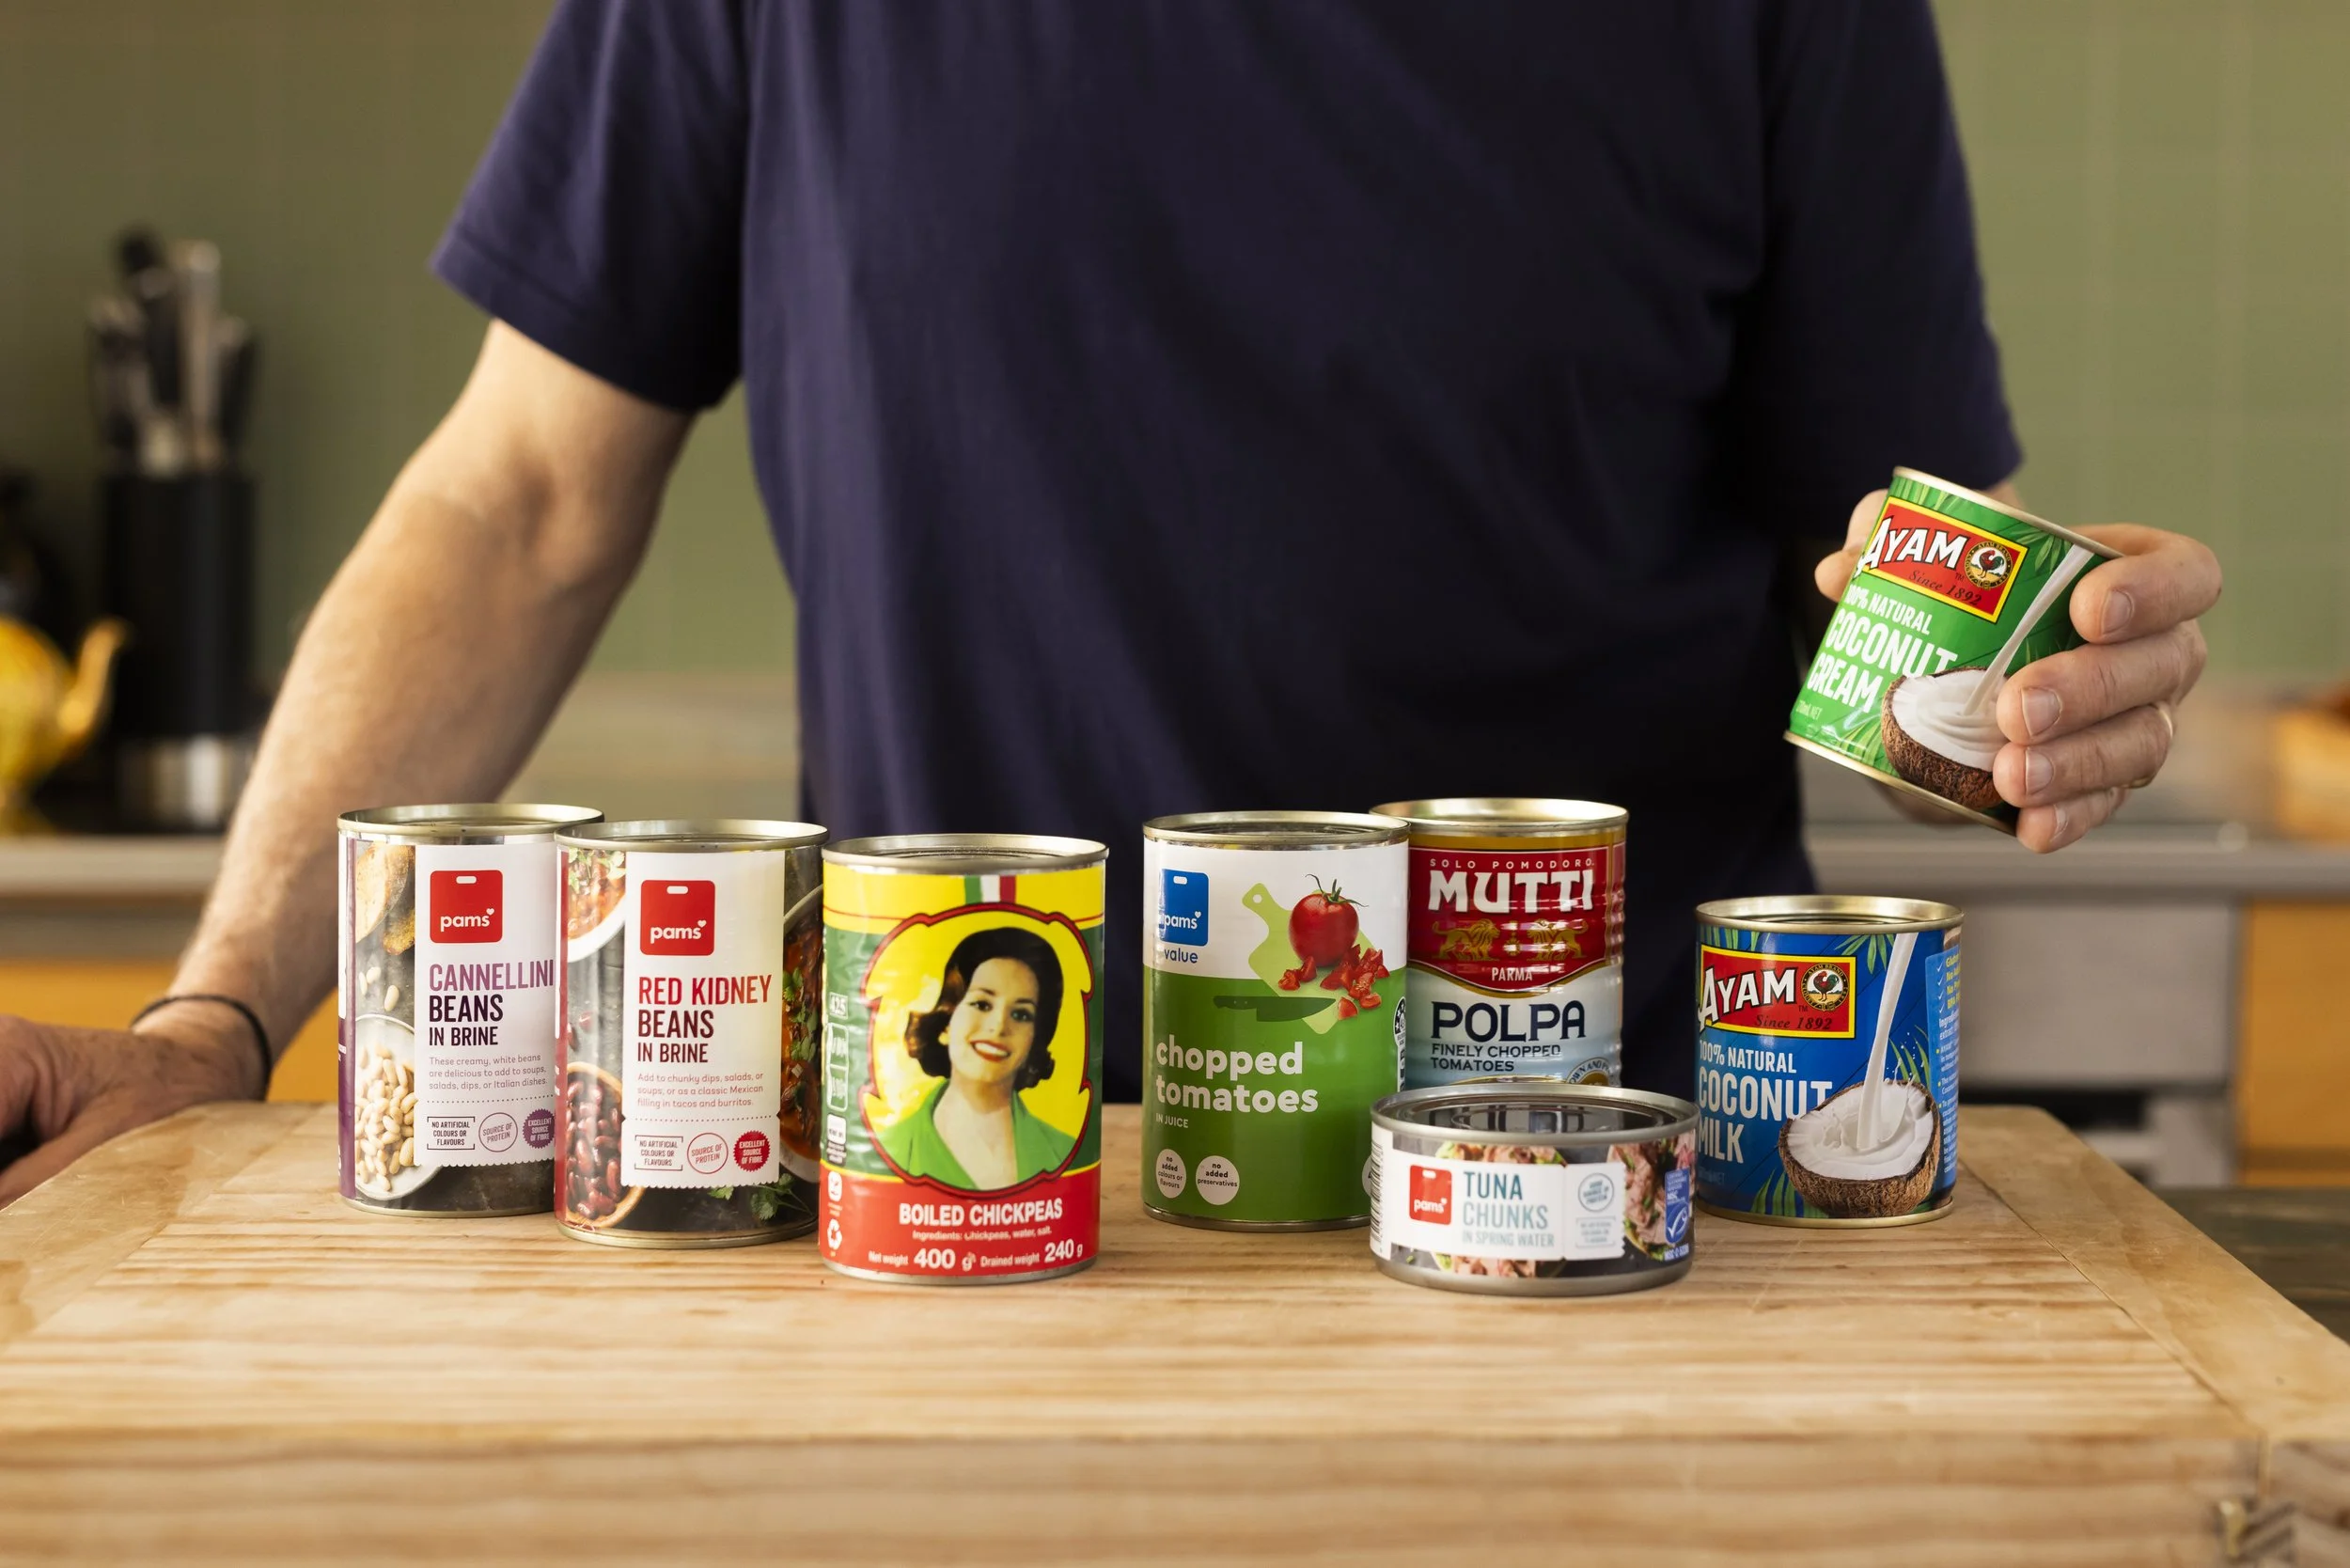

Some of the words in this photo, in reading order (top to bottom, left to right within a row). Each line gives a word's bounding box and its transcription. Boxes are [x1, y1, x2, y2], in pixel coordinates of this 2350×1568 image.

[1853, 517, 1967, 579] AYAM
[1908, 570, 1943, 592] Since
[1947, 584, 1982, 606] 1892
[1868, 593, 1933, 635] NATURAL
[1825, 608, 1958, 679] COCONUT
[1807, 652, 1884, 713] CREAM
[1430, 858, 1476, 870] SOLO
[1492, 857, 1593, 870] POMODORO
[1428, 869, 1594, 914] MUTTI
[440, 914, 491, 933] pams
[1164, 914, 1198, 938] pams
[650, 926, 702, 944] pams
[1164, 948, 1198, 964] value
[429, 959, 555, 992] CANNELLINI
[1491, 966, 1533, 981] PARMA
[638, 977, 682, 1005] RED
[692, 974, 773, 1006] KIDNEY
[1698, 966, 1796, 1031] AYAM
[429, 994, 504, 1023] BEANS
[638, 1010, 714, 1039] BEANS
[1431, 1000, 1587, 1043] POLPA
[1755, 1014, 1791, 1028] Since
[1796, 1017, 1832, 1030] 1892
[429, 1027, 445, 1046] IN
[450, 1026, 498, 1046] BRINE
[637, 1043, 653, 1062] IN
[660, 1043, 709, 1063] BRINE
[1155, 1034, 1304, 1082] chopped
[1431, 1043, 1483, 1058] FINELY
[1487, 1043, 1560, 1058] CHOPPED
[1700, 1040, 1725, 1066] 100%
[1728, 1046, 1797, 1074] NATURAL
[429, 1057, 454, 1066] These
[456, 1058, 492, 1068] creamy,
[494, 1056, 516, 1065] white
[517, 1054, 541, 1063] beans
[1430, 1058, 1514, 1072] TOMATOES
[445, 1069, 482, 1078] delicious
[483, 1069, 494, 1077] to
[494, 1067, 510, 1076] add
[511, 1067, 521, 1075] to
[522, 1065, 546, 1075] soups,
[637, 1073, 655, 1082] Add
[667, 1074, 699, 1085] chunky
[701, 1073, 722, 1084] dips,
[725, 1072, 754, 1082] salads,
[429, 1080, 459, 1090] salads,
[461, 1080, 481, 1091] dips,
[494, 1079, 520, 1089] Italian
[522, 1077, 548, 1086] dishes.
[637, 1087, 665, 1097] soups,
[697, 1085, 728, 1095] classic
[729, 1085, 763, 1094] Mexican
[1155, 1074, 1319, 1114] tomatoes
[1699, 1066, 1832, 1121] COCONUT
[637, 1098, 661, 1110] filling
[662, 1098, 671, 1107] in
[672, 1099, 697, 1107] tacos
[699, 1097, 715, 1107] and
[717, 1097, 754, 1106] burritos.
[527, 1118, 552, 1127] EXCELLENT
[1155, 1112, 1164, 1124] IN
[1165, 1115, 1189, 1129] JUICE
[482, 1124, 505, 1137] SOURCE
[487, 1132, 510, 1143] PROTEIN
[739, 1139, 766, 1149] EXCELLENT
[1698, 1118, 1745, 1164] MILK
[691, 1145, 714, 1157] SOURCE
[696, 1153, 721, 1164] PROTEIN
[743, 1148, 762, 1156] SOURCE
[644, 1158, 672, 1167] FLAVOURS
[1162, 1163, 1179, 1172] added
[1158, 1170, 1176, 1180] colours
[1197, 1178, 1238, 1187] preservatives
[1463, 1170, 1523, 1200] TUNA
[899, 1202, 964, 1227] BOILED
[969, 1198, 1063, 1227] CHICKPEAS
[1413, 1198, 1445, 1214] pams
[1463, 1200, 1548, 1230] CHUNKS
[912, 1230, 964, 1242] Ingredients:
[1012, 1229, 1037, 1238] water,
[1037, 1225, 1052, 1236] salt.
[1463, 1231, 1473, 1245] IN
[1475, 1231, 1514, 1247] SPRING
[1517, 1232, 1554, 1248] WATER
[868, 1249, 883, 1262] Net
[882, 1253, 909, 1268] weight
[914, 1248, 957, 1270] 400
[979, 1254, 1013, 1268] Drained
[1014, 1252, 1041, 1267] weight
[1044, 1238, 1074, 1263] 240
[1076, 1243, 1084, 1259] g
